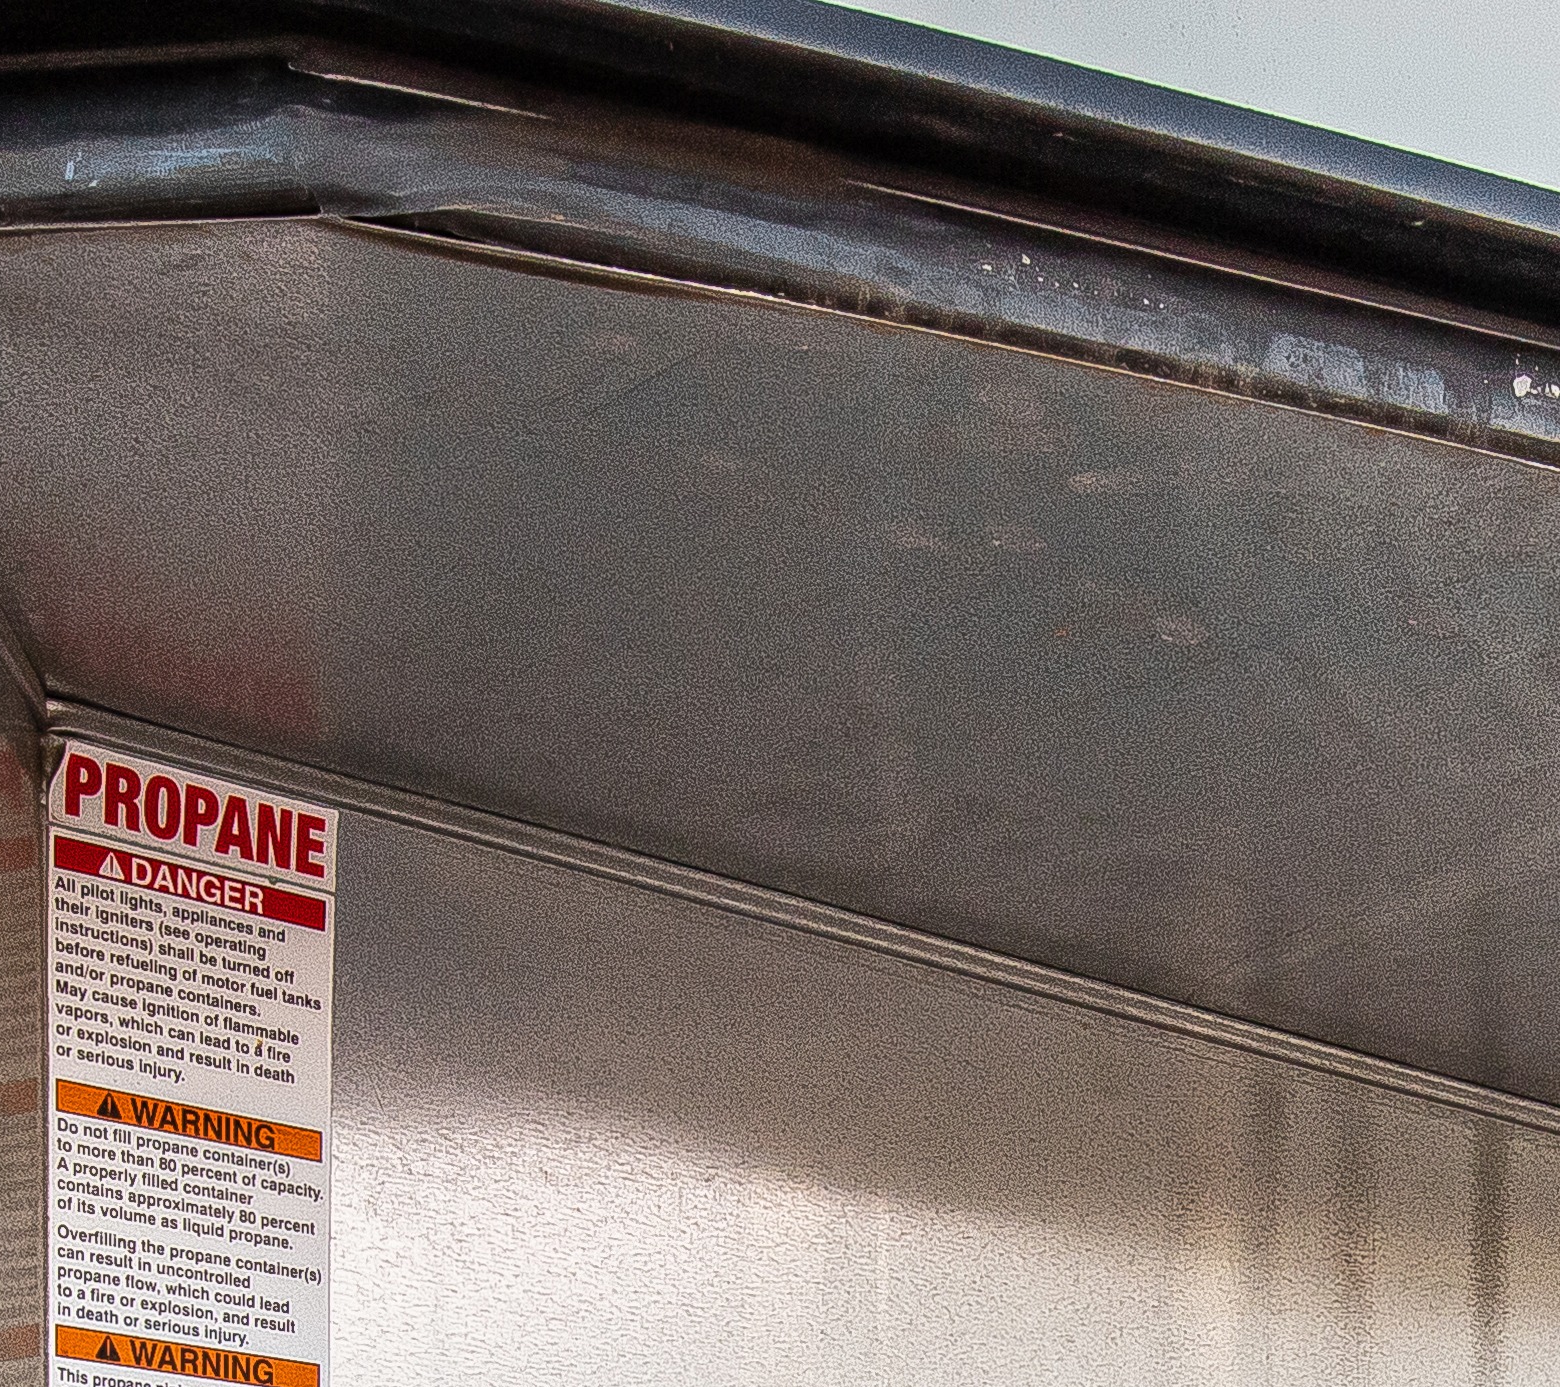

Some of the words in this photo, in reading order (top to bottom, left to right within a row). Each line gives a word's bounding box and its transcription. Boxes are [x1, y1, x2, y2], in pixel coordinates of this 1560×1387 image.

[65, 753, 326, 878] PROPANE
[53, 875, 76, 894] All
[79, 882, 116, 903] pilot
[119, 889, 168, 918] lights,
[171, 905, 254, 936] appliances
[256, 925, 286, 943] and
[132, 857, 263, 914] DANGER
[55, 978, 88, 1003] May
[91, 989, 138, 1010] cause
[141, 996, 200, 1024] ignition
[203, 1013, 220, 1028] of
[222, 1015, 300, 1046] flammable
[56, 1116, 79, 1135] Do
[82, 1124, 109, 1141] not
[112, 1127, 132, 1146] fill
[135, 1135, 199, 1158] propane
[202, 1148, 291, 1179] container(s)
[130, 1097, 275, 1150] WARNING
[55, 1136, 73, 1153] to
[76, 1142, 117, 1162] more
[119, 1148, 155, 1169] than
[158, 1155, 177, 1173] 80
[180, 1162, 238, 1185] percent
[241, 1172, 257, 1188] of
[259, 1177, 324, 1203] capacity.
[56, 1223, 137, 1255] Overfilling
[140, 1238, 166, 1256] the
[168, 1246, 232, 1268] propane
[234, 1257, 322, 1286] container(s)
[56, 1365, 89, 1386] This
[129, 1340, 274, 1385] WARNING
